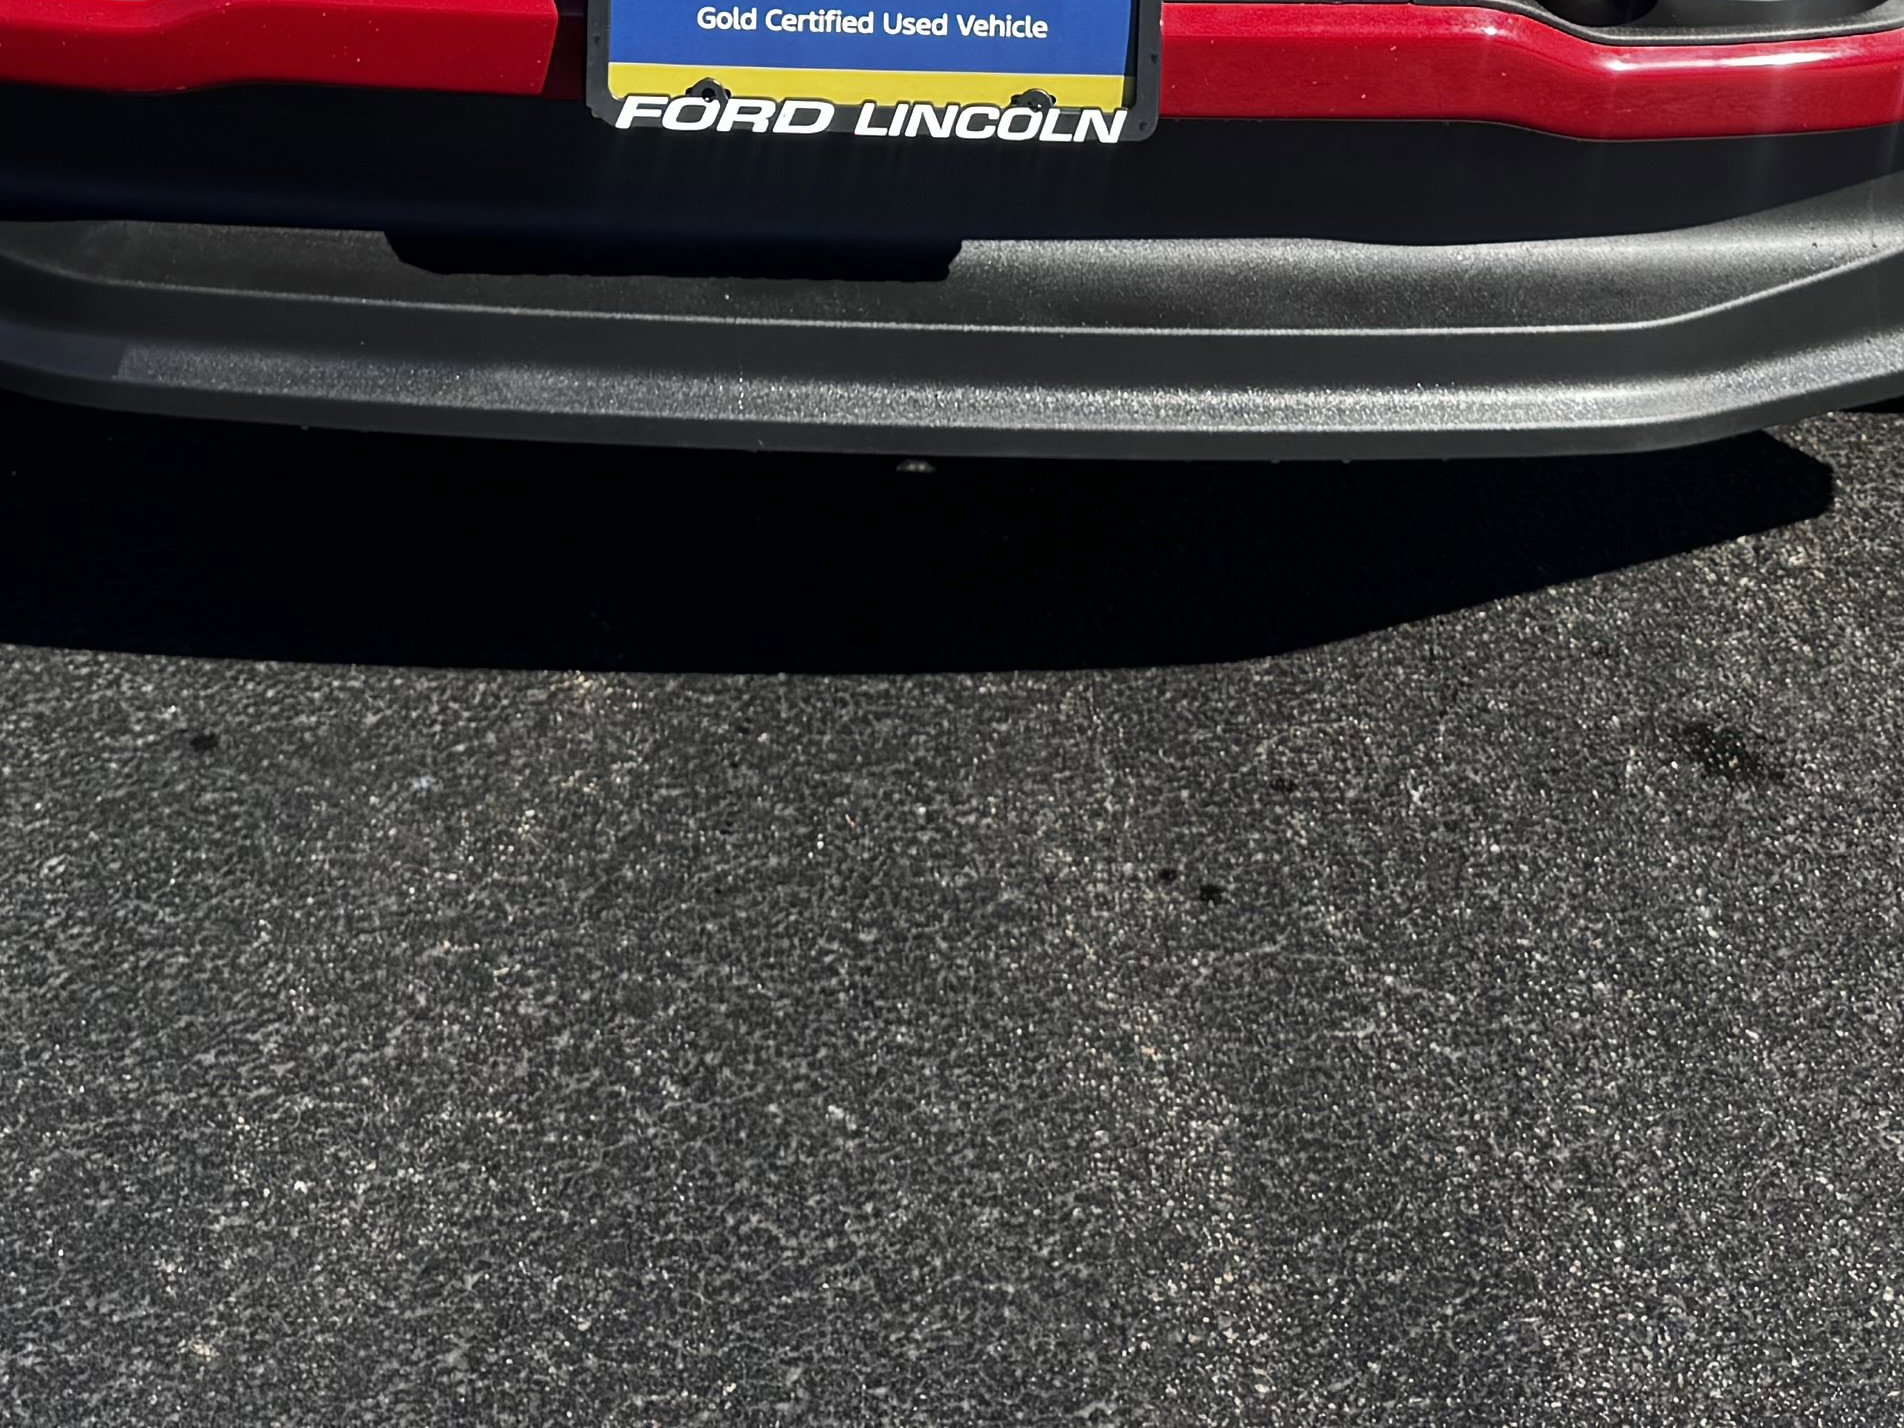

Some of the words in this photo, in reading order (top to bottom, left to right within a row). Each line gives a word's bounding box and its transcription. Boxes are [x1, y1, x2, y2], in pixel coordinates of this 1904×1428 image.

[696, 6, 758, 30] Gold
[765, 8, 875, 34] Certified
[882, 12, 949, 36] Used
[956, 13, 1049, 39] Vehicle
[615, 95, 836, 134] FORD
[854, 102, 1128, 144] LINCOLN
